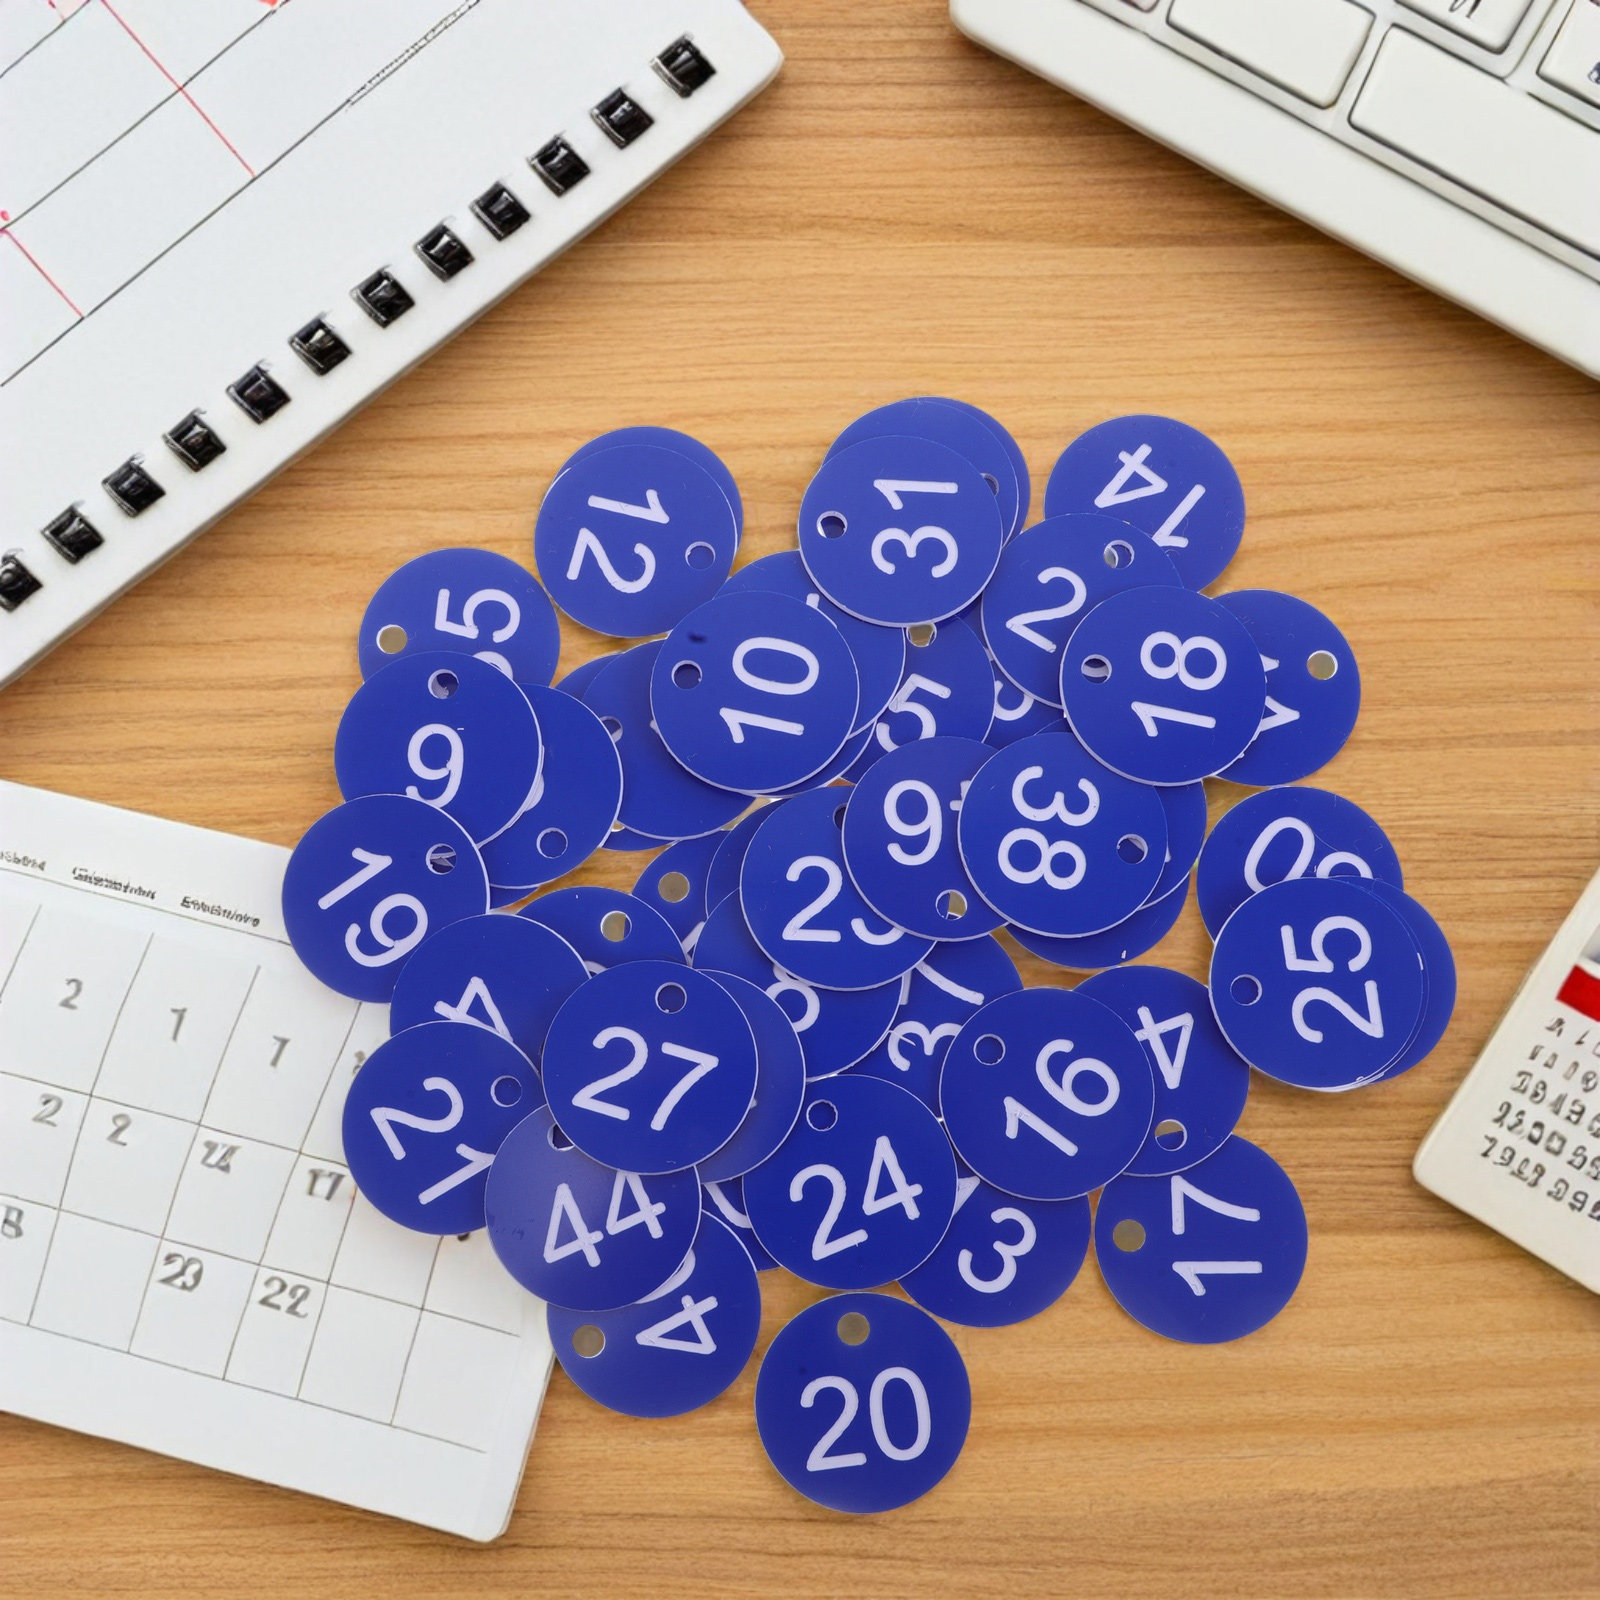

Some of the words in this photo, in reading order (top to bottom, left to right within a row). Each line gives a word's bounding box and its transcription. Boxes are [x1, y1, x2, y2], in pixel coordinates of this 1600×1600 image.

[567, 488, 670, 594] 12
[871, 478, 959, 578] 31
[1093, 443, 1207, 548] 14
[1005, 566, 1087, 653] 2
[719, 636, 820, 744] 10
[1130, 630, 1228, 738] 18
[406, 722, 464, 809] 9
[997, 765, 1100, 891] 38
[317, 847, 429, 968] 19
[1281, 915, 1384, 1044] 25
[571, 1026, 719, 1132] 27
[1003, 1038, 1121, 1157] 16
[1133, 1005, 1194, 1090] 4
[370, 1076, 495, 1205] 21
[543, 1170, 666, 1268] 44
[789, 1136, 923, 1262] 24
[954, 1177, 1037, 1294] 3
[1171, 1175, 1262, 1297] 17
[800, 1366, 932, 1472] 20
